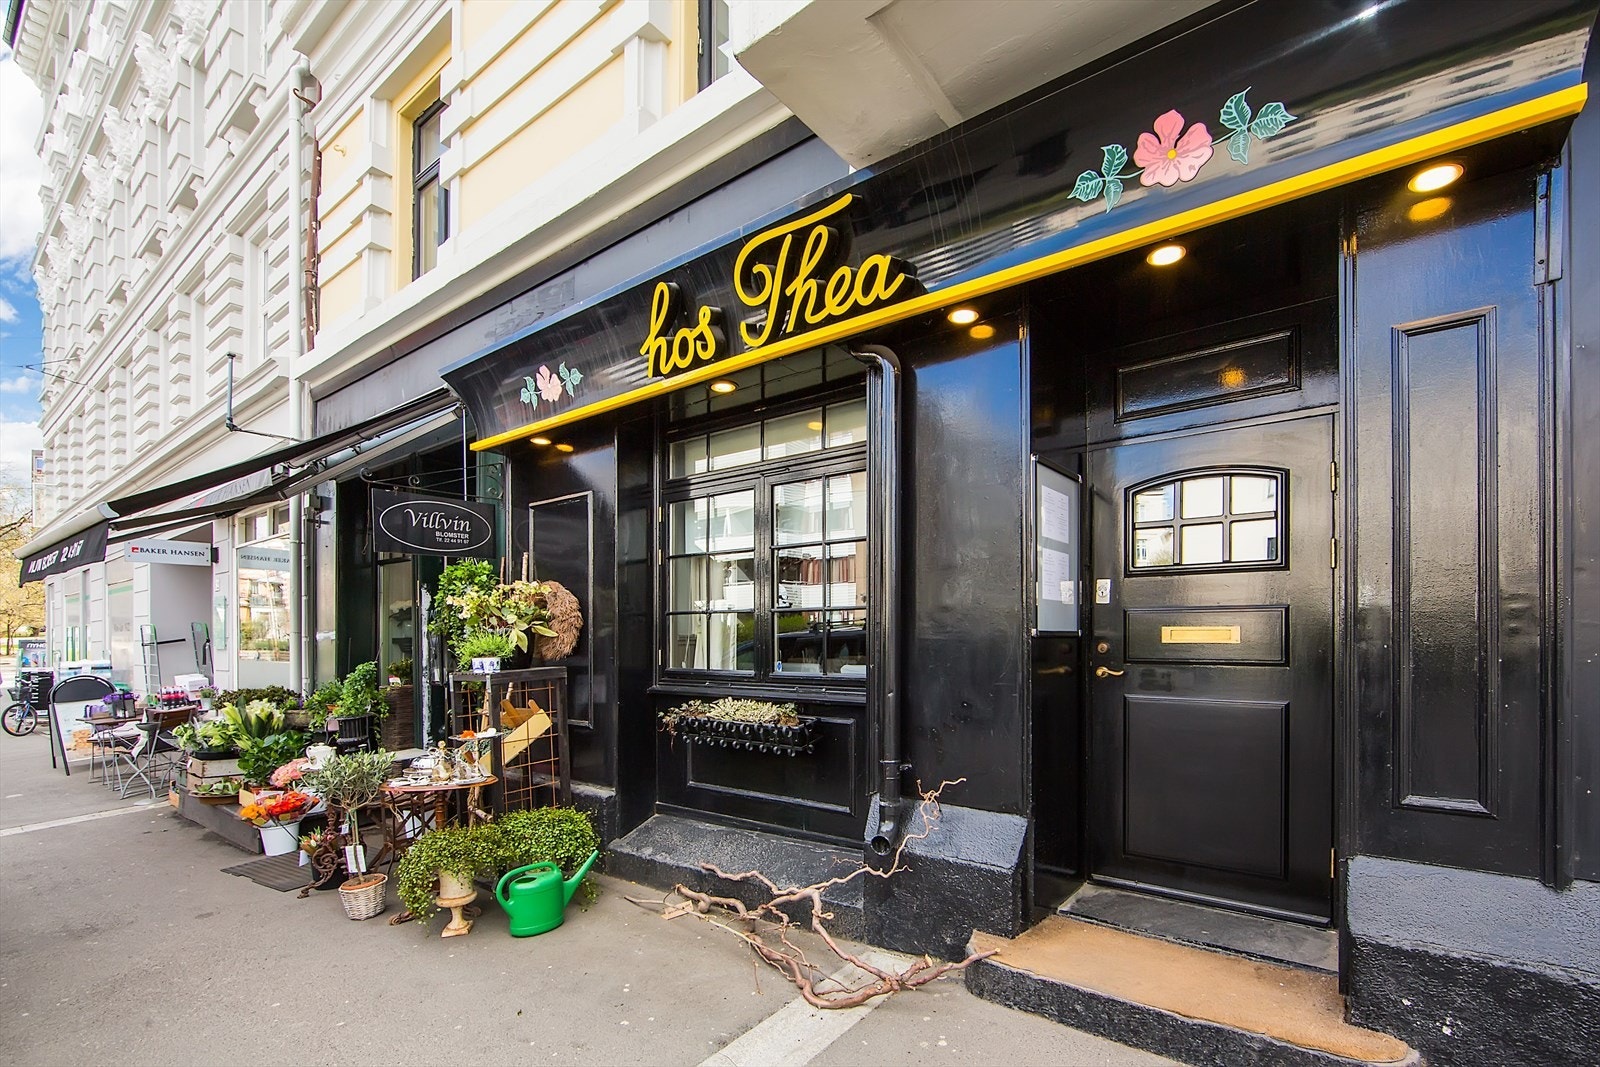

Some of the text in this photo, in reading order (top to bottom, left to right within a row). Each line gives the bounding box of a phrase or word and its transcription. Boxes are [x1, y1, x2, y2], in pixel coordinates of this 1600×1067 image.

[640, 193, 905, 378] hos Thea
[404, 508, 471, 532] Villvin
[139, 547, 206, 557] BAKER HANSEN
